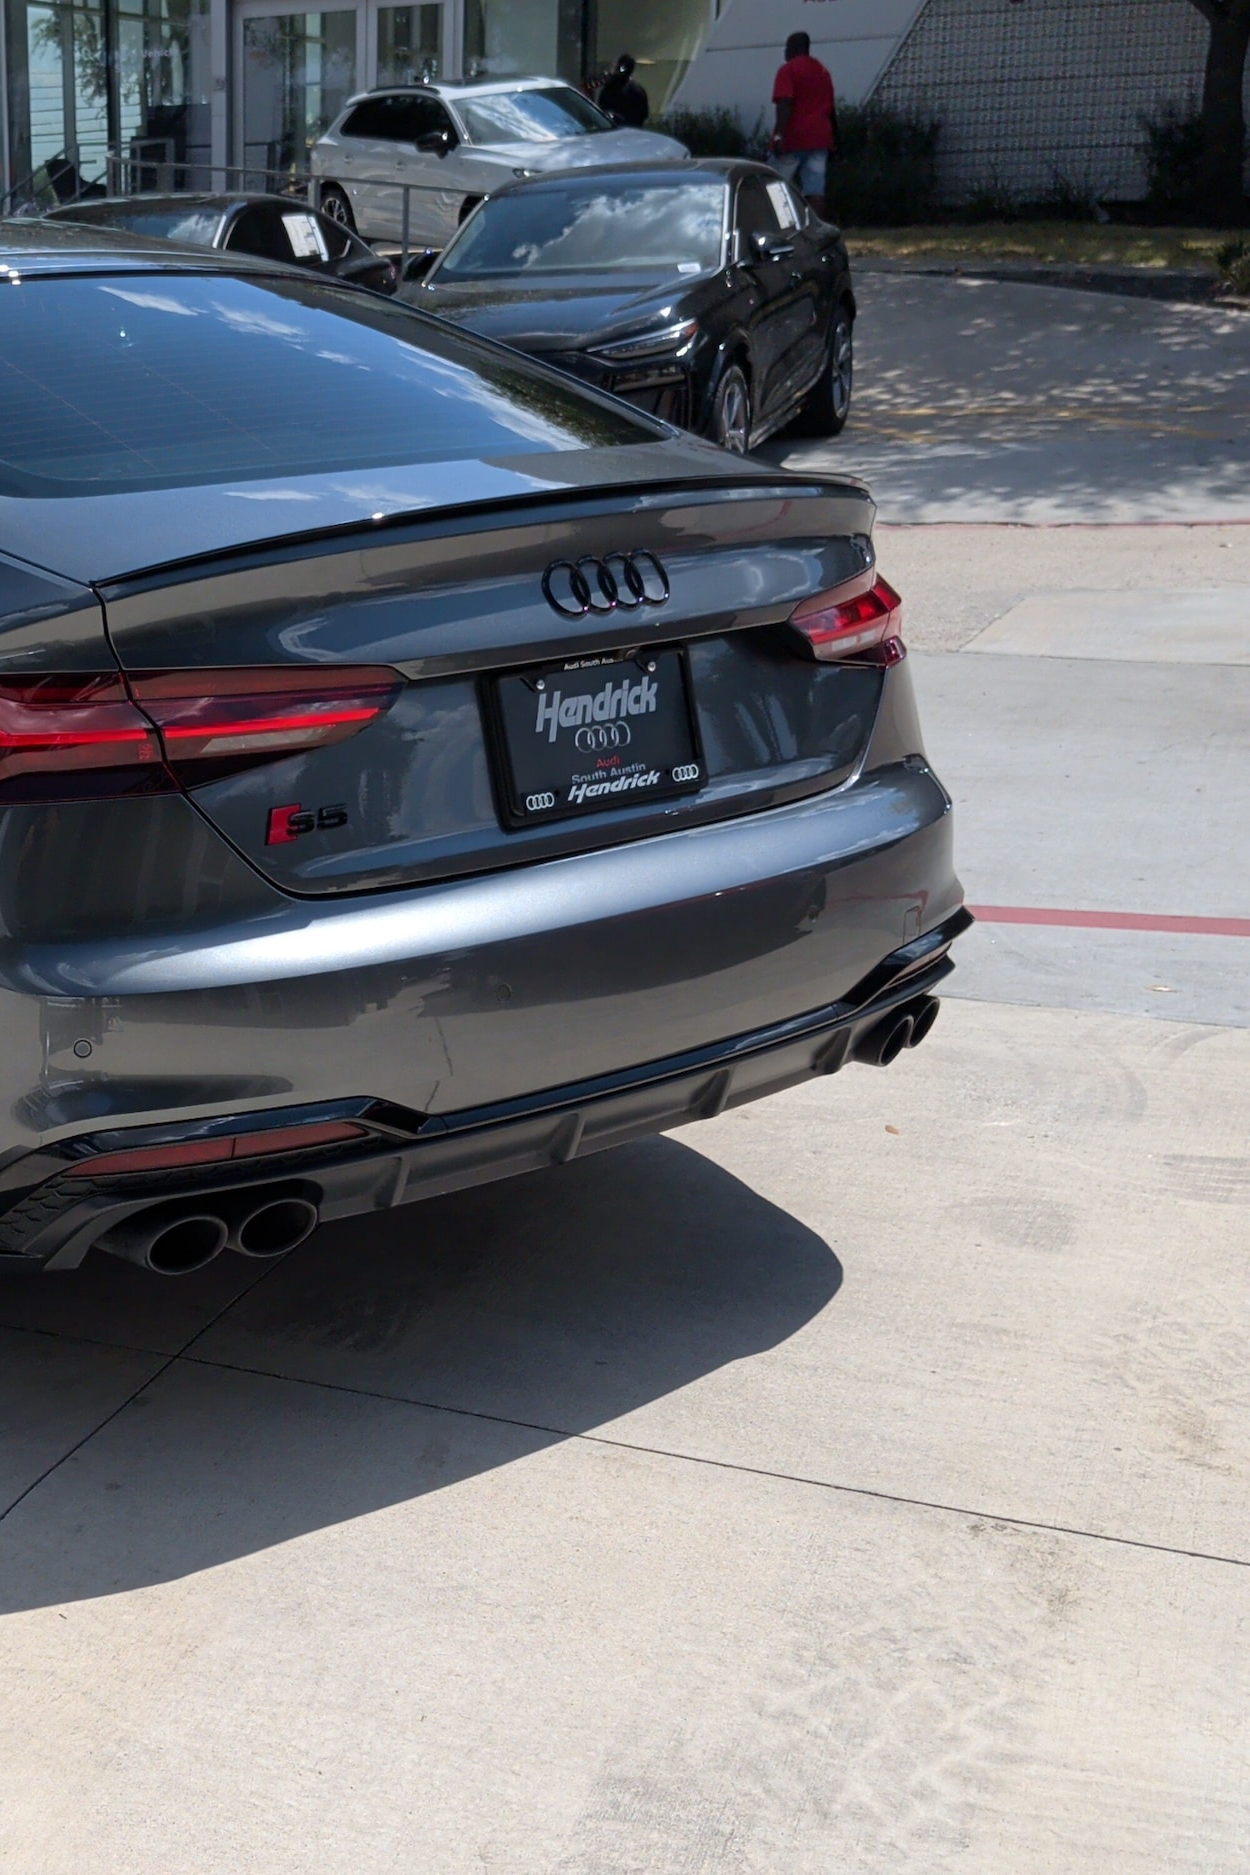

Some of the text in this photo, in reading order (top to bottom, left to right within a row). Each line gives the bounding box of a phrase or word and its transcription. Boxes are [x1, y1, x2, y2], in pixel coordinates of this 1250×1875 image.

[563, 661, 580, 671] Audi
[580, 658, 601, 668] South
[535, 675, 659, 743] Hendrick
[571, 762, 647, 784] South Austin
[596, 755, 621, 768] Audi
[567, 769, 661, 804] Hendrick
[286, 803, 349, 837] S5
